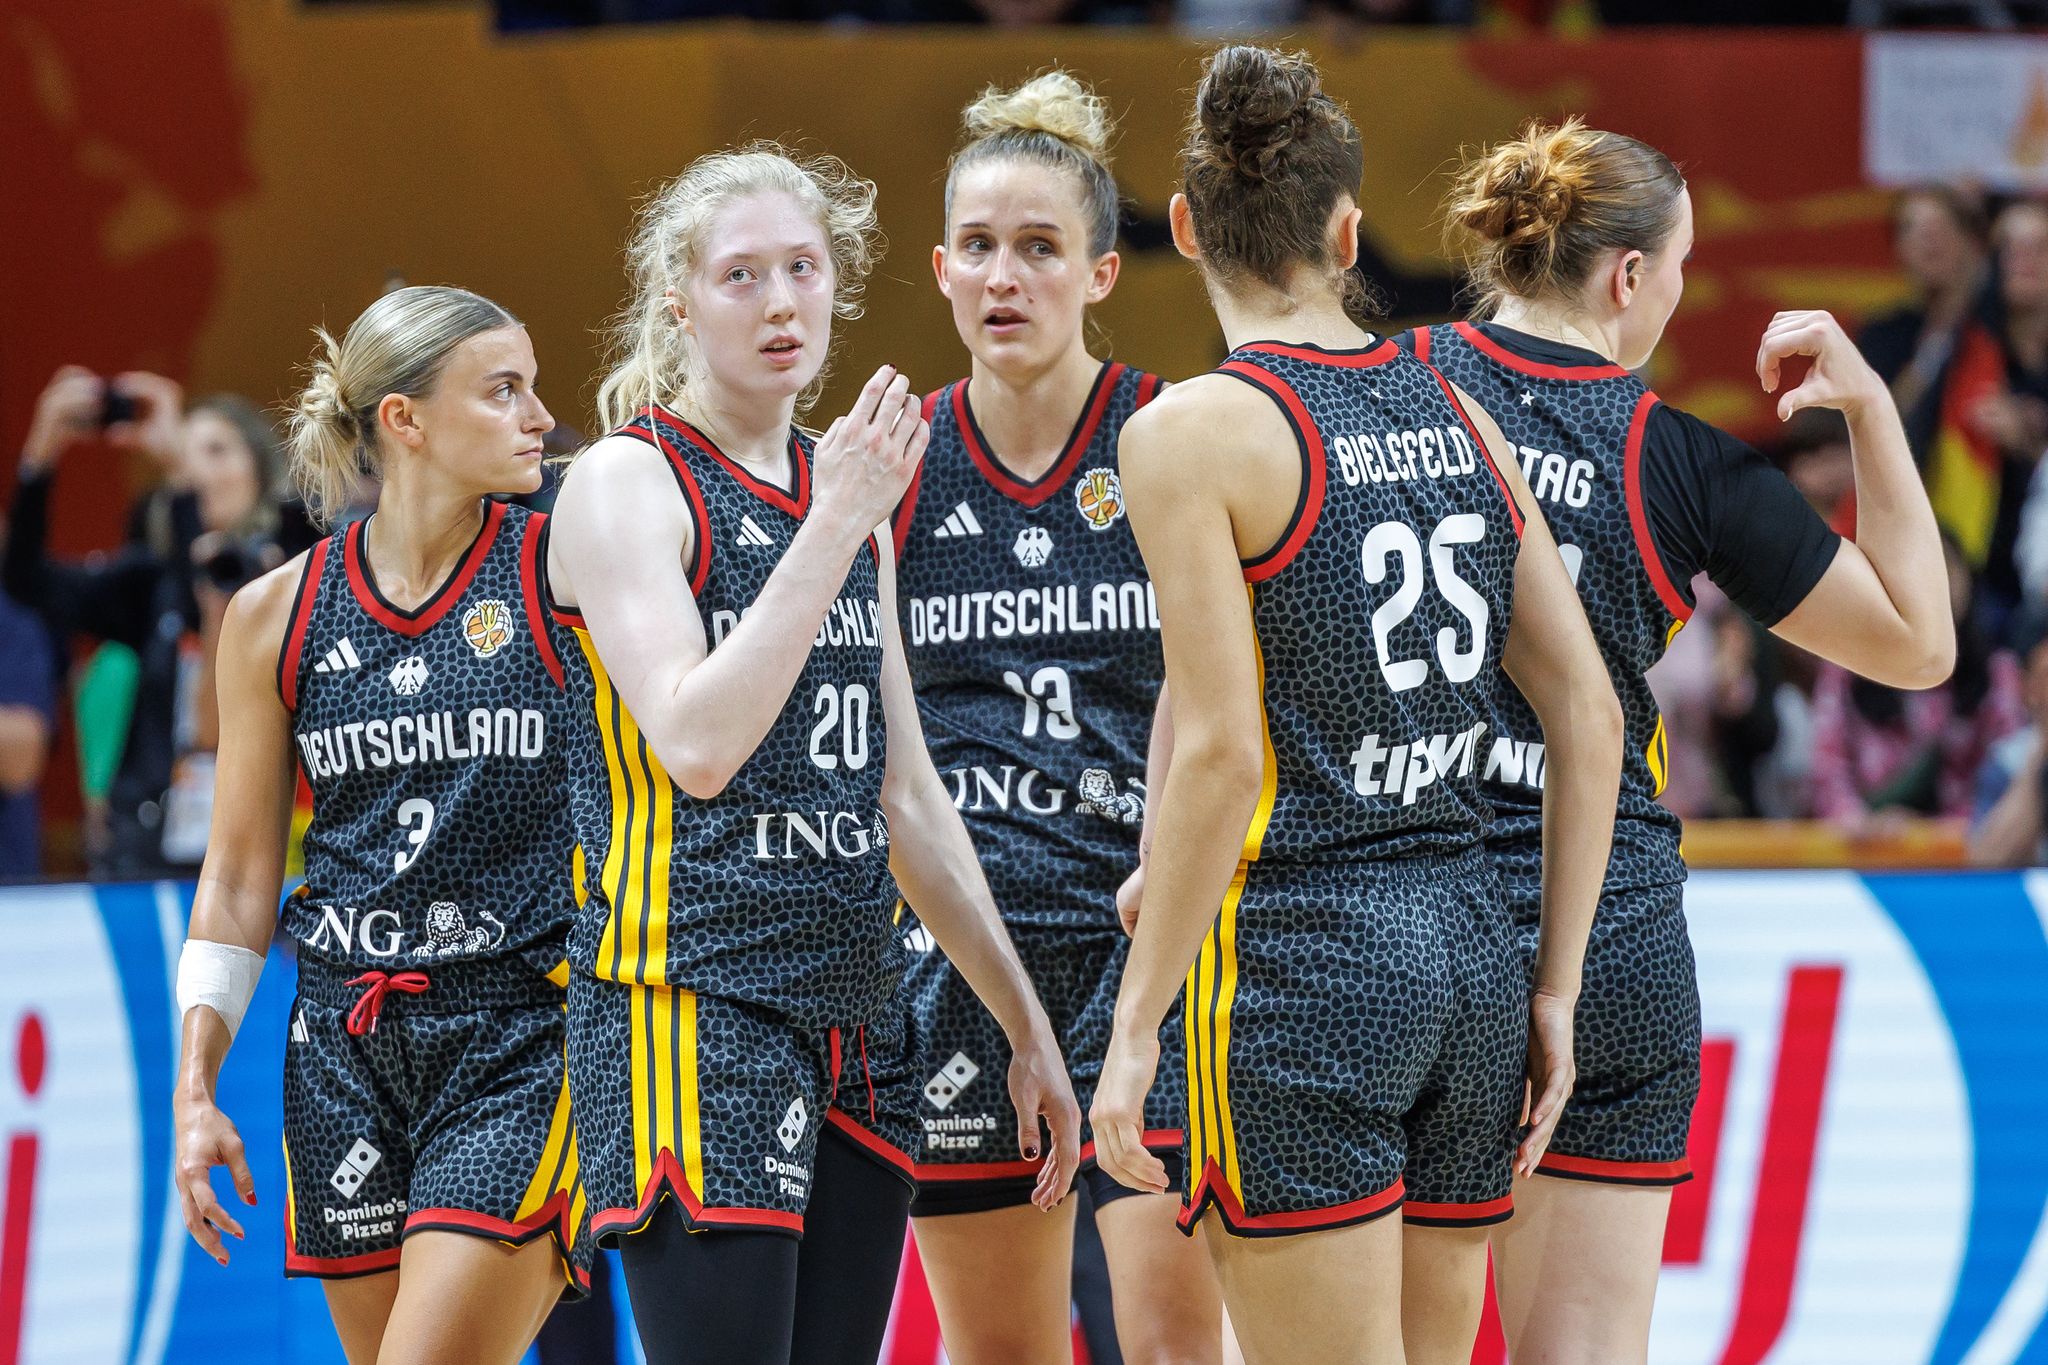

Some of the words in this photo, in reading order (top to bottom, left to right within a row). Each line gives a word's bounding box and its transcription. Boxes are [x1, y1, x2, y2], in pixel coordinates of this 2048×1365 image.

[1333, 426, 1476, 486] BIELEFELD
[1361, 513, 1489, 692] 25
[809, 683, 870, 770] 20
[1003, 666, 1082, 741] 13
[297, 708, 545, 781] DEUTSCHLAND
[951, 765, 1067, 816] ING
[394, 798, 435, 875] 3
[753, 810, 871, 859] ING
[920, 1112, 997, 1132] omino's
[928, 1132, 980, 1150] Pizza
[765, 1156, 809, 1182] Domino's
[780, 1177, 805, 1198] Pizza
[323, 1197, 407, 1224] Domino's
[341, 1222, 394, 1240] Pizza
